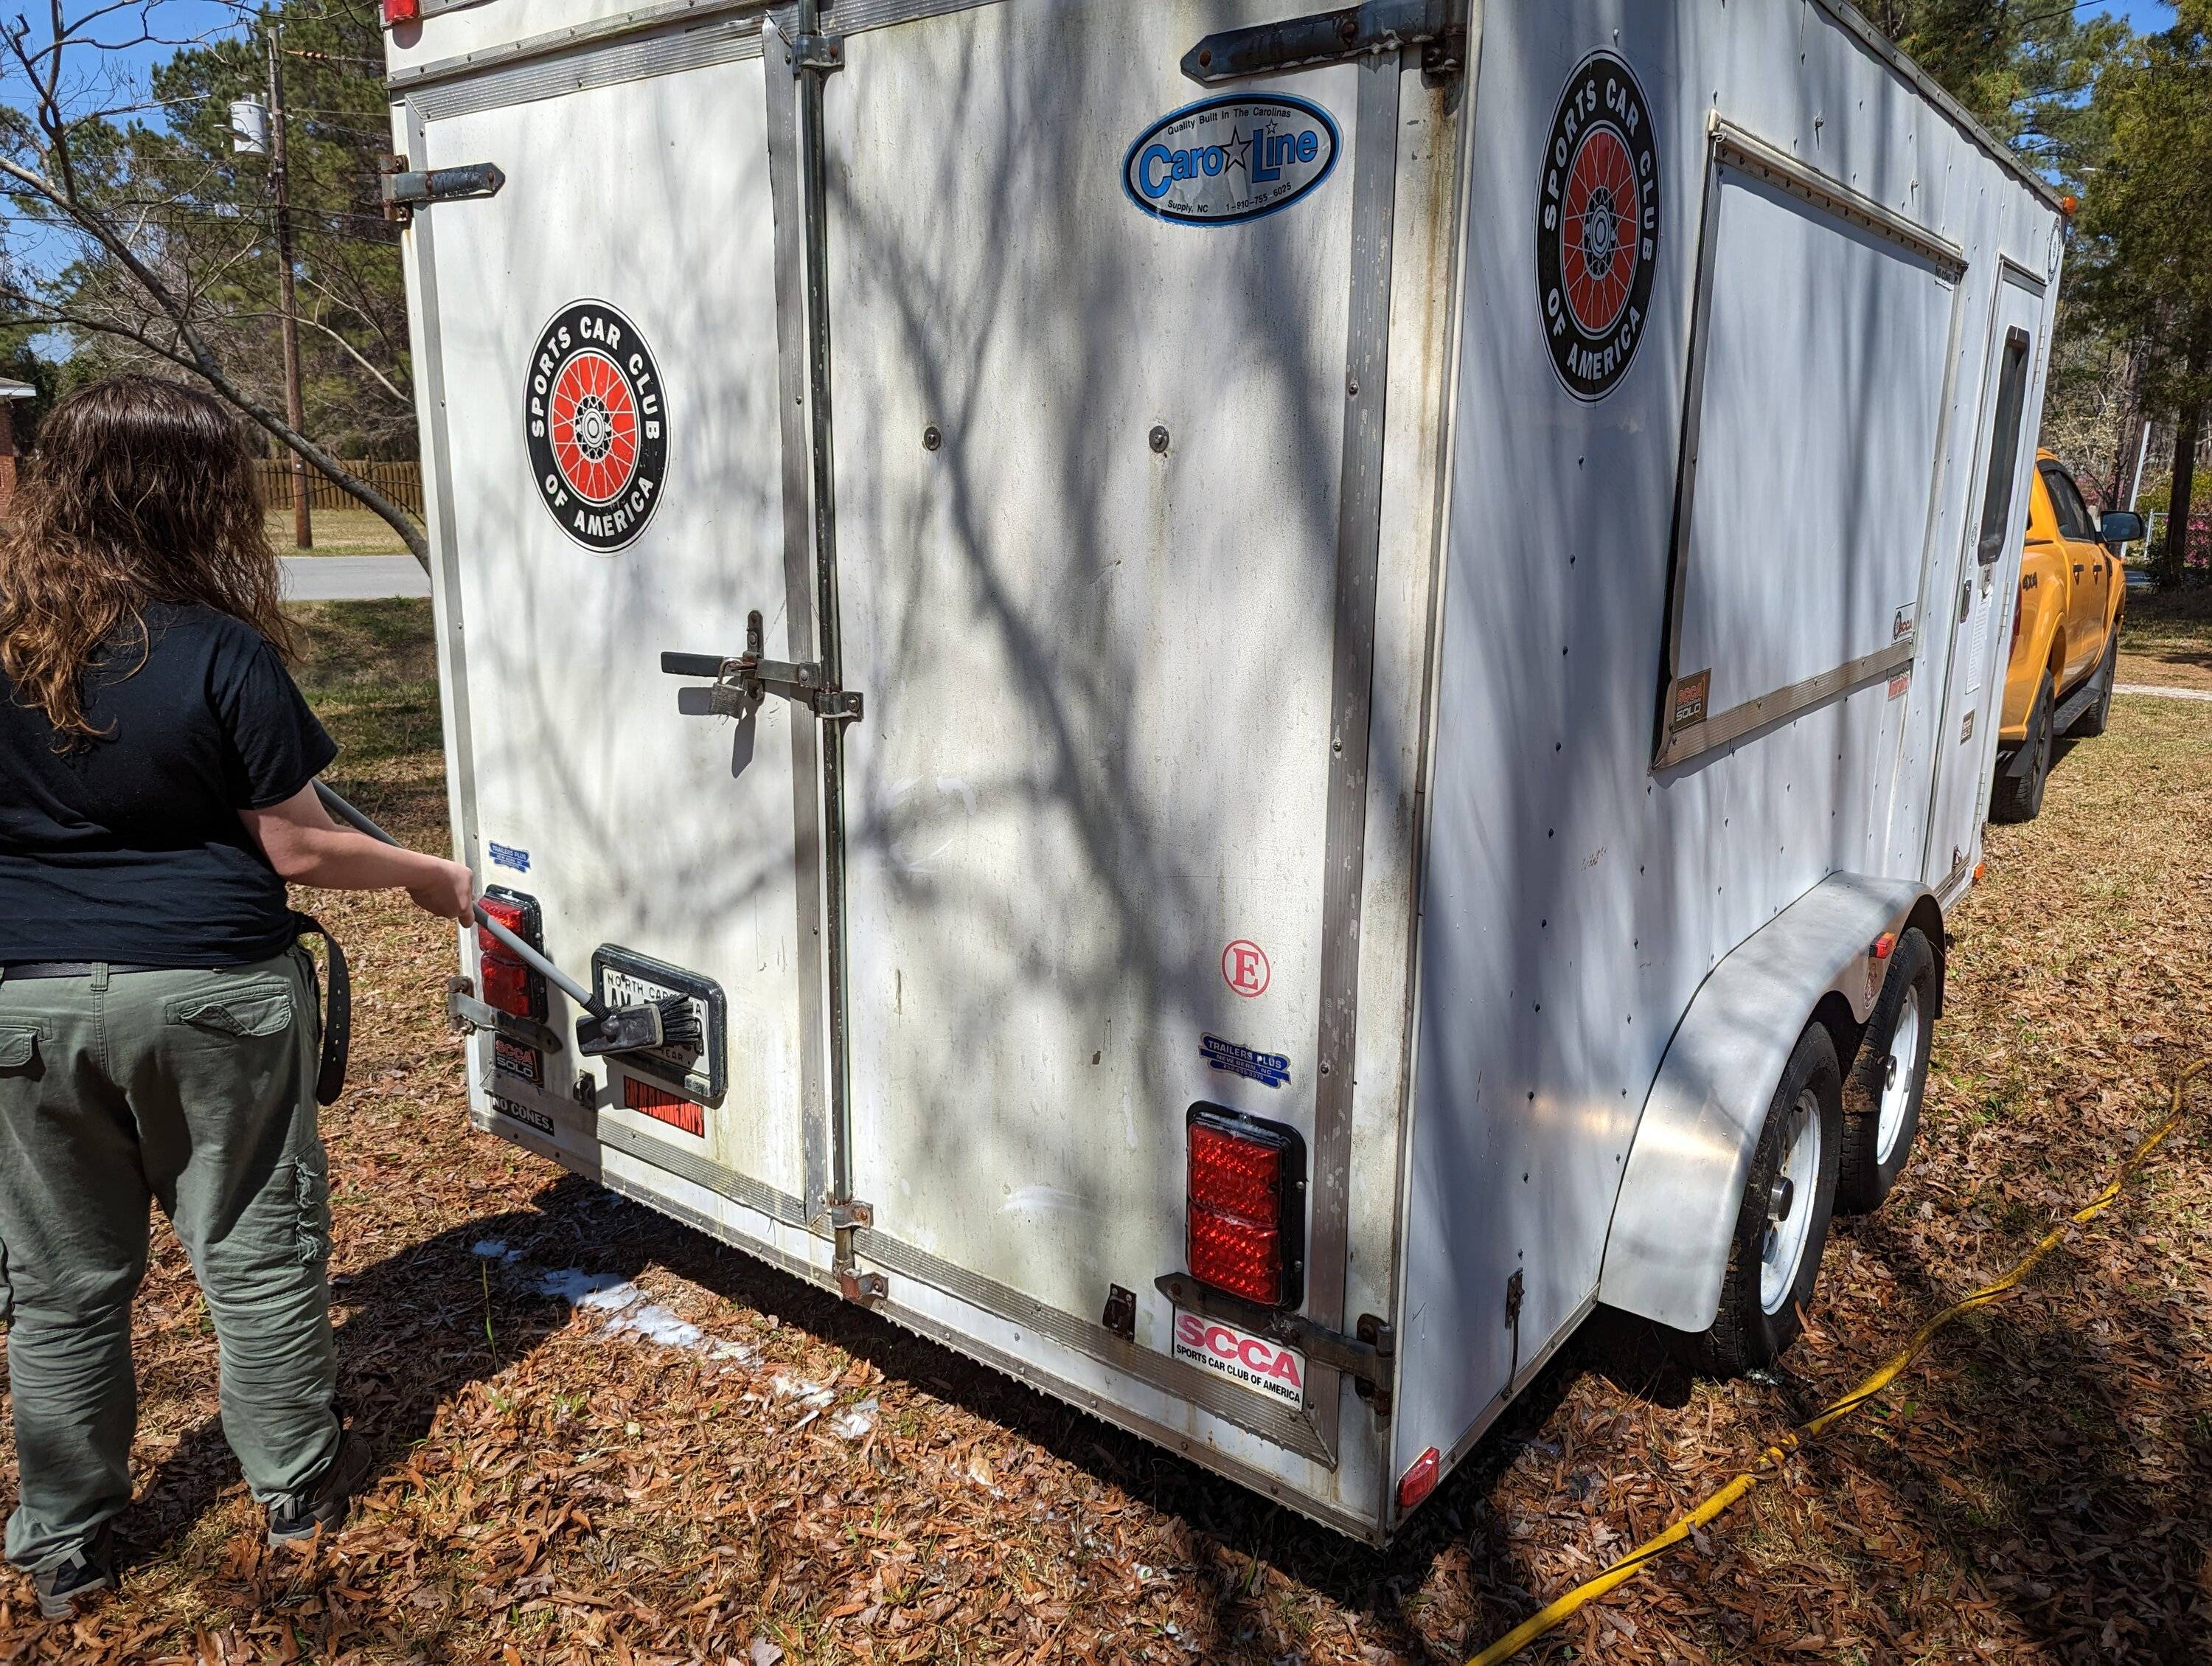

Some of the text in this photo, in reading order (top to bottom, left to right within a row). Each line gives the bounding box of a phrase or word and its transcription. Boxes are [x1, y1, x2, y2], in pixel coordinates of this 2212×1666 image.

[1167, 107, 1291, 135] Quality Built In The Carolinas
[1139, 128, 1318, 199] Caro Line
[1545, 77, 1655, 262] SPORTS CAR CLUB
[1168, 200, 1208, 213] Supply, NC
[1548, 288, 1640, 381] OF AMERICA
[531, 316, 661, 440] SPORTS CAR CLUB
[545, 473, 654, 537] OF AMERICA
[1676, 702, 1701, 722] SOLO
[492, 844, 526, 861] TRAILERS PLUS
[607, 973, 644, 996] NORTH
[1233, 948, 1259, 990] E
[495, 1040, 532, 1063] SCCA
[497, 1056, 533, 1077] SOLO
[1208, 1040, 1281, 1069] TRAILERS PLUS
[1216, 1054, 1235, 1065] NEW
[1236, 1061, 1258, 1072] BERN,
[492, 1096, 554, 1132] NO CONES.
[1175, 1314, 1302, 1389] SCCA
[1176, 1344, 1301, 1403] SPORTS CAR CLUB OF AMERICA
